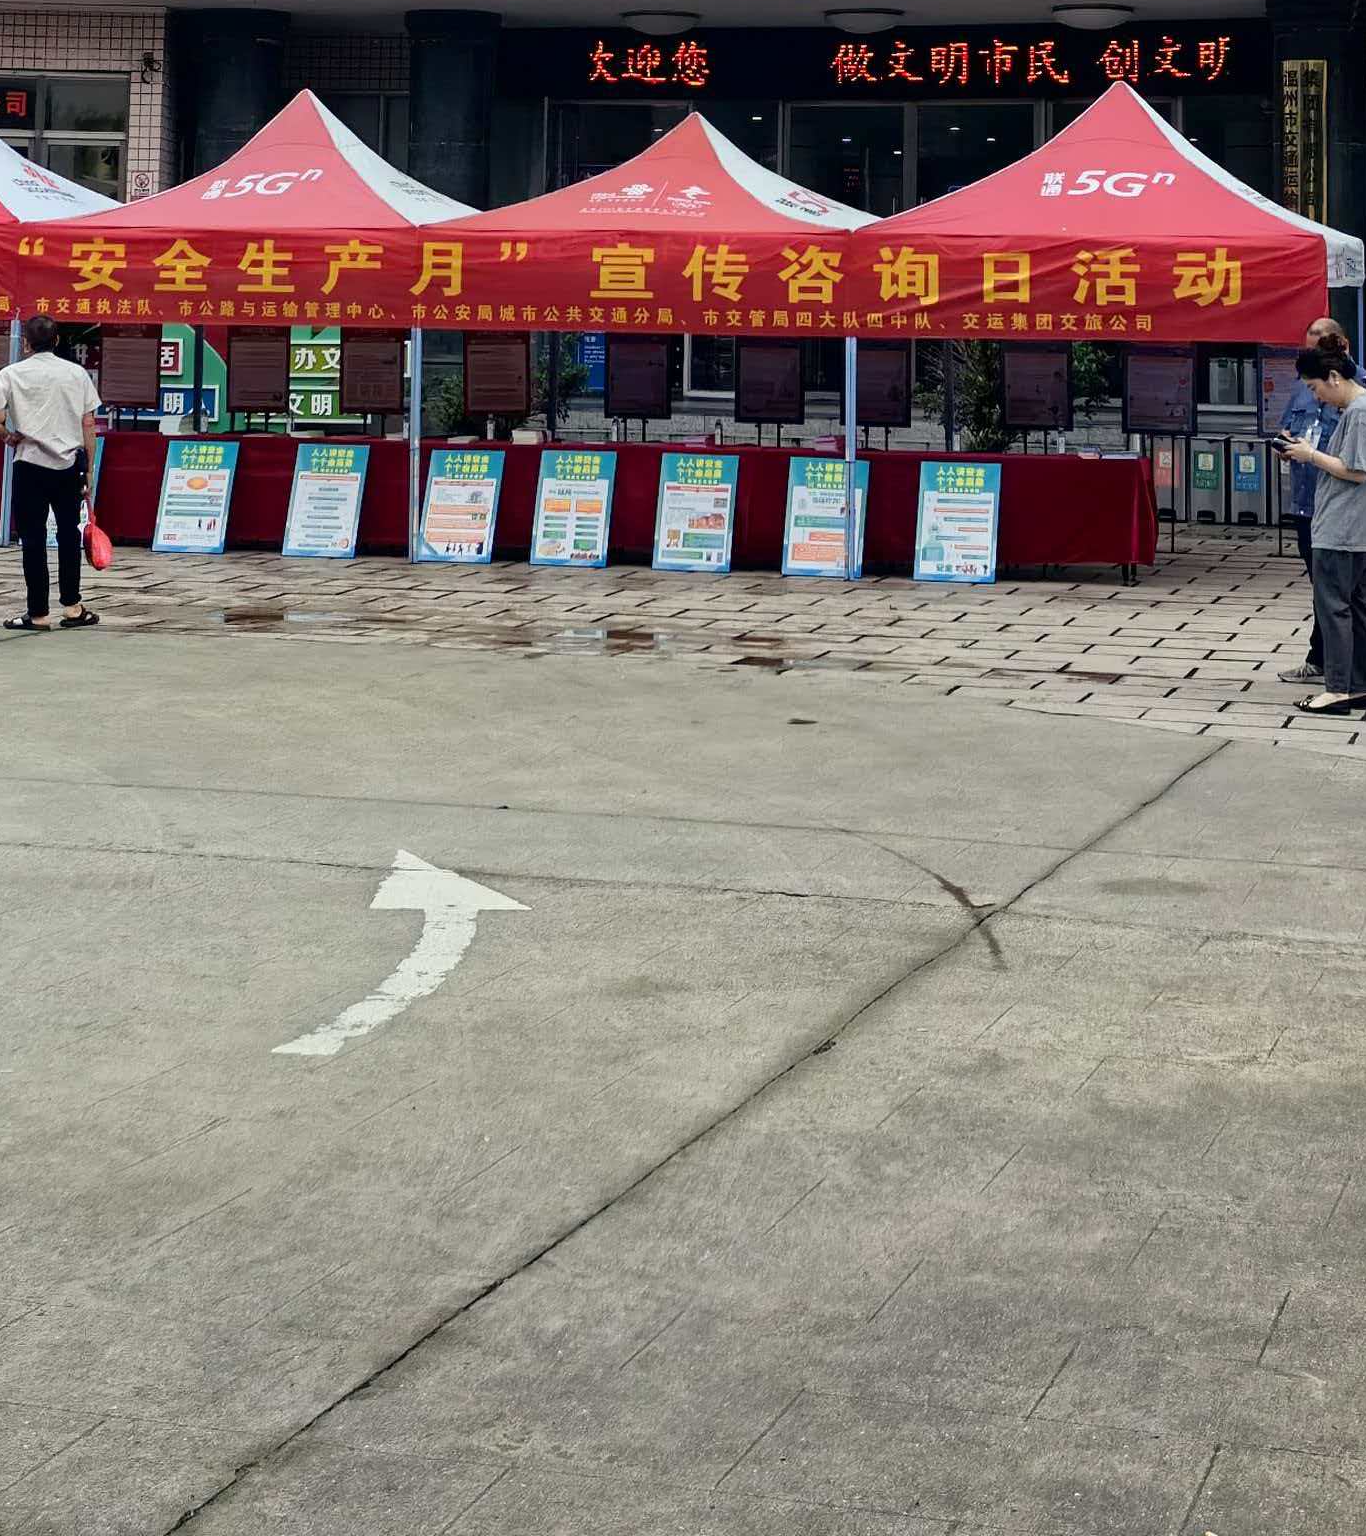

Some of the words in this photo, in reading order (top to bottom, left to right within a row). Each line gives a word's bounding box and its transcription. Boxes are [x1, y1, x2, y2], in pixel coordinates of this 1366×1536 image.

[830, 38, 1069, 85] 做文明市民
